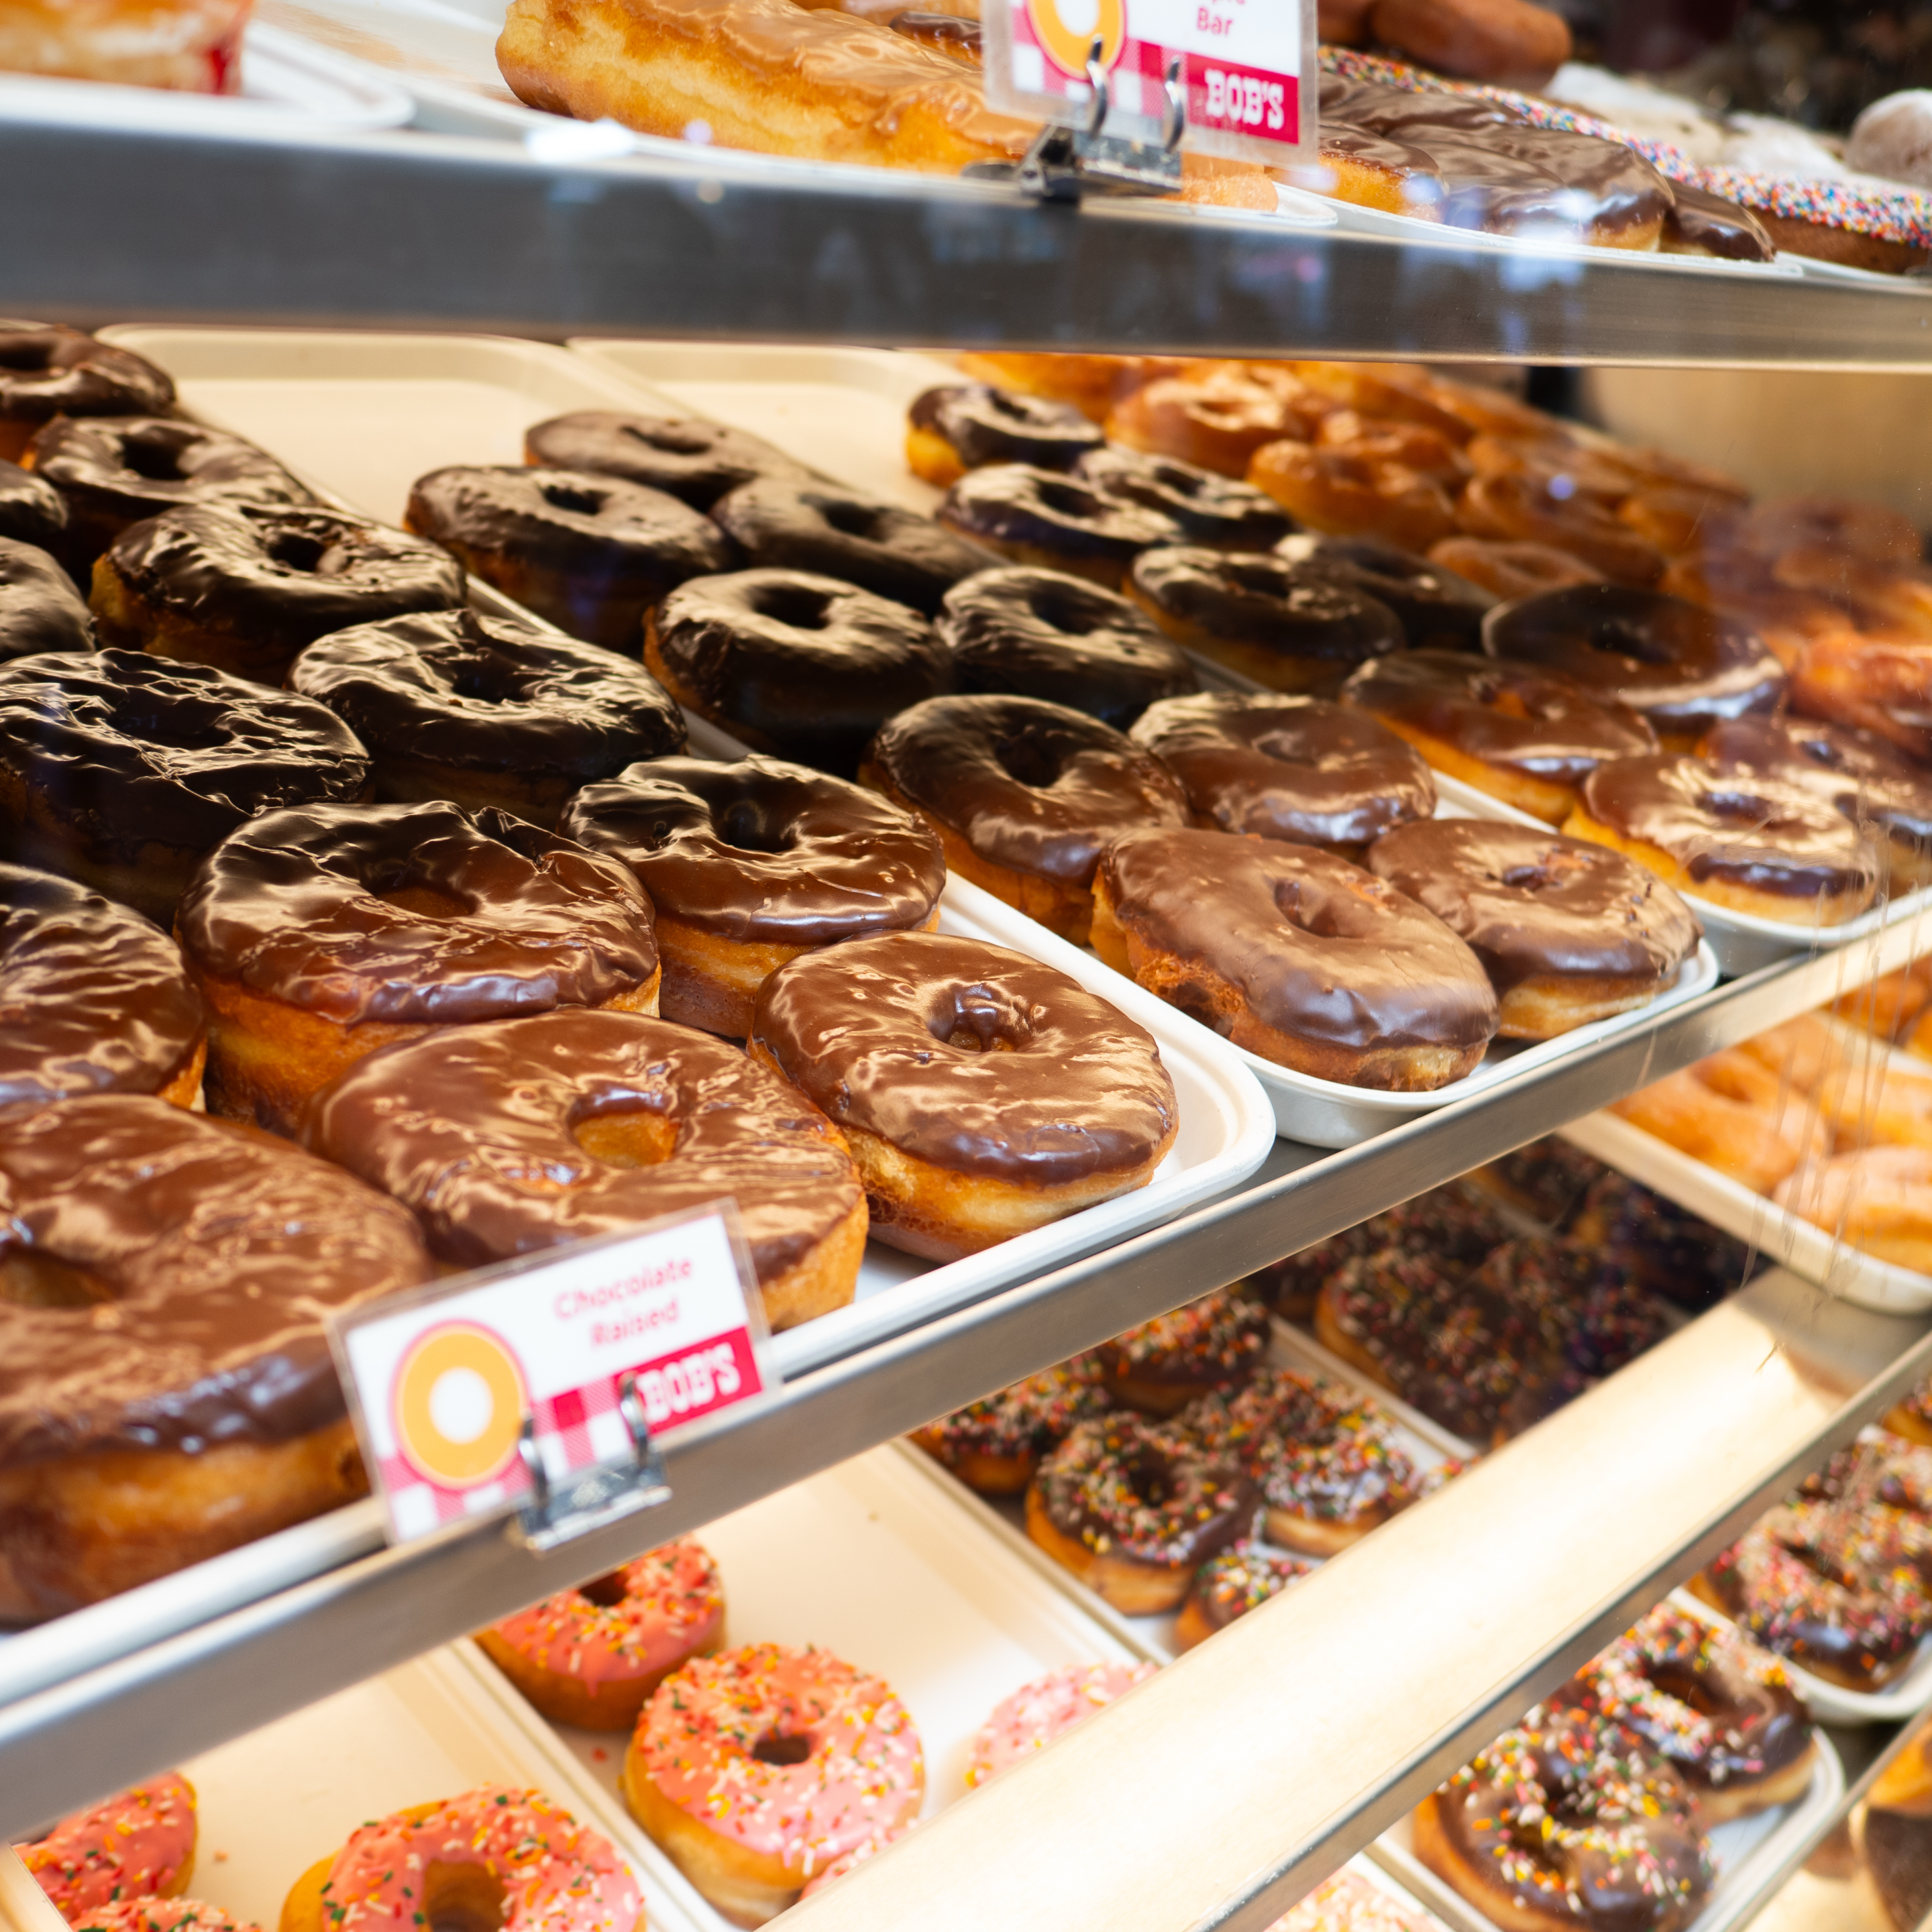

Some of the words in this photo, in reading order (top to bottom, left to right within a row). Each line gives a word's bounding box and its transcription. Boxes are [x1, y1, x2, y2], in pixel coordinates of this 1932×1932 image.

[1197, 7, 1233, 36] Bar
[1205, 70, 1285, 129] BOB'S
[554, 1258, 692, 1320] Chocolate
[592, 1298, 679, 1347] Raised
[637, 1342, 741, 1421] BOB'S
